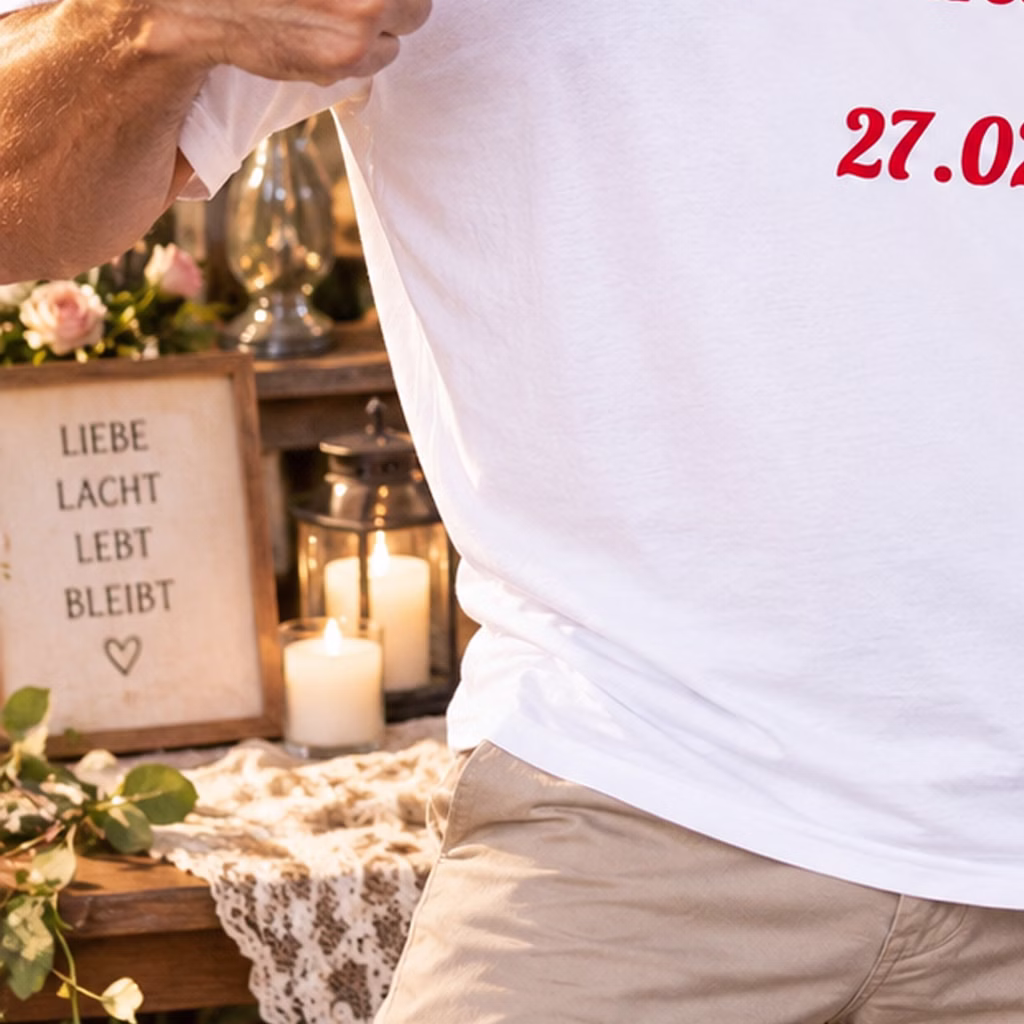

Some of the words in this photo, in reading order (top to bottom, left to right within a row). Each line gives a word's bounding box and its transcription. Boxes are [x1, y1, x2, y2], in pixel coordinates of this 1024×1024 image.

[59, 419, 149, 457] LIEBE
[55, 471, 161, 511] LACHT
[74, 526, 152, 564] LEBT
[63, 578, 174, 620] BLEIBT
